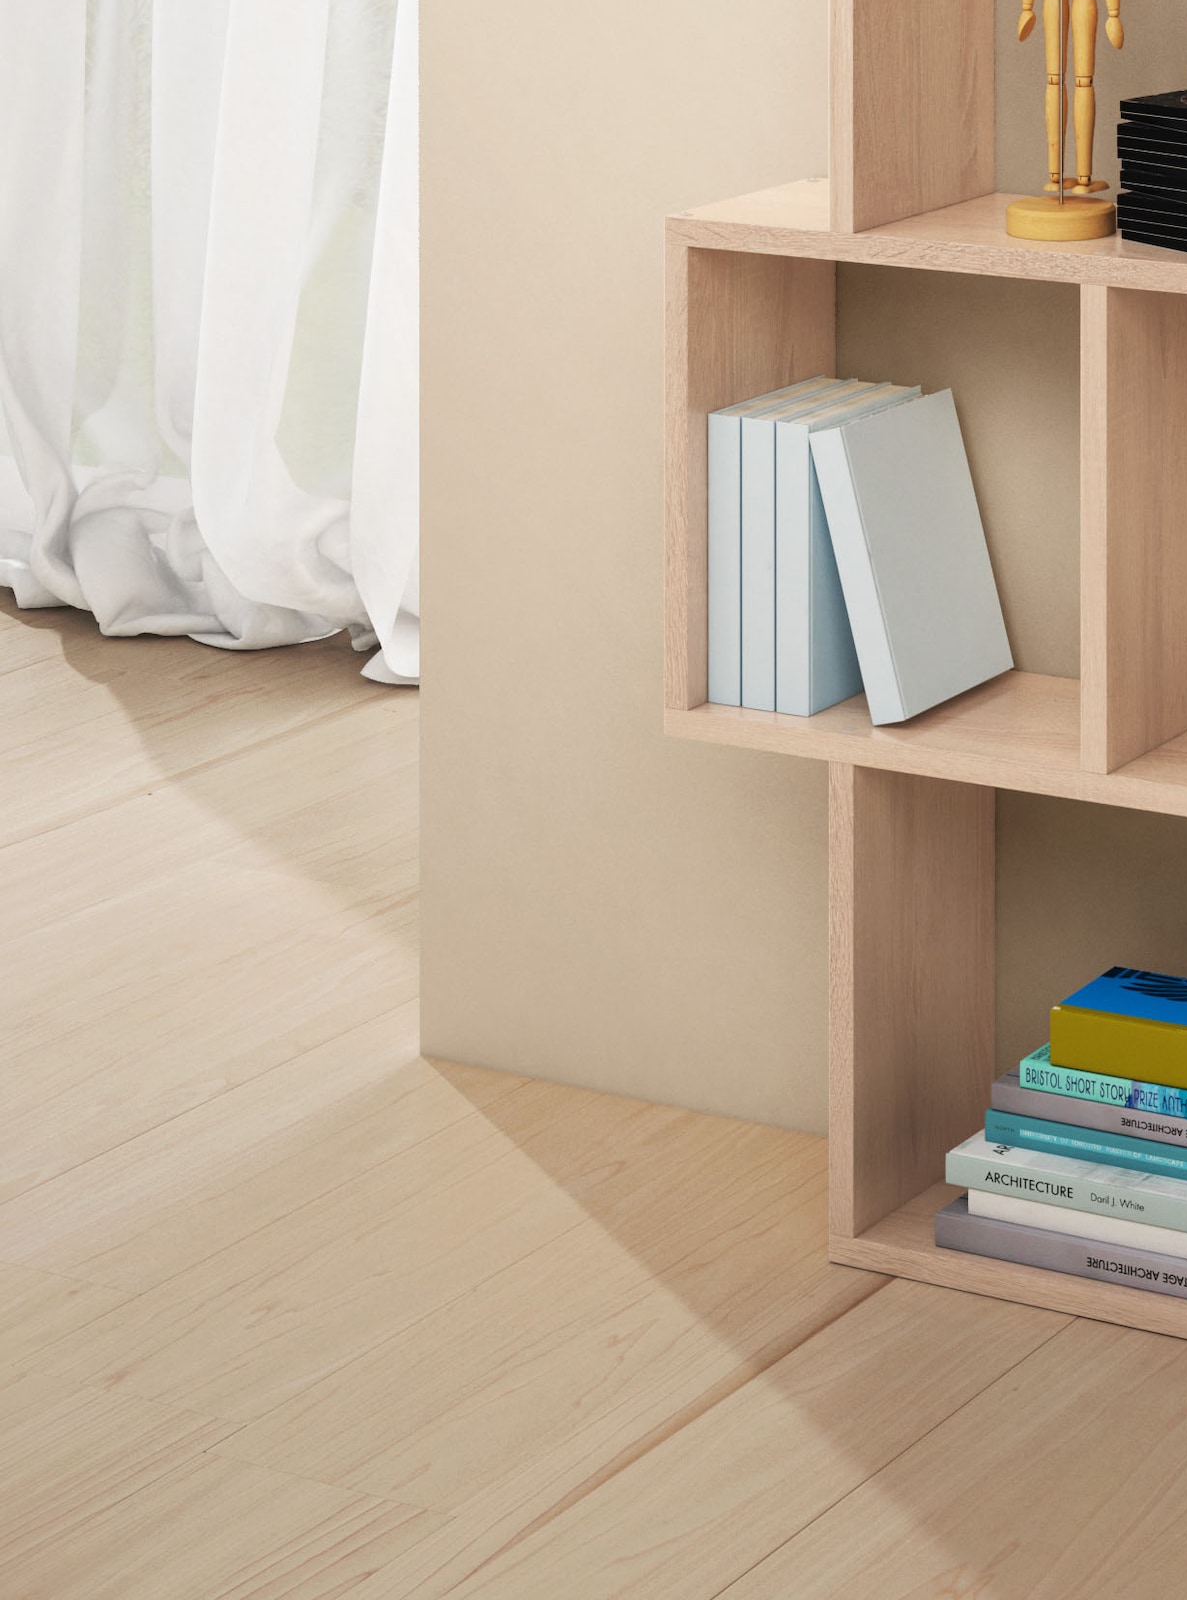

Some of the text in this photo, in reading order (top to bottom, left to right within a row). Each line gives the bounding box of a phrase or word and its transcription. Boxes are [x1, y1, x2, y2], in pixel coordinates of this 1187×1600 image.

[1025, 1067, 1062, 1089] BRISTOL
[1065, 1075, 1096, 1095] SHORT
[1099, 1082, 1130, 1103] STORY
[1133, 1088, 1158, 1109] PRIZE
[1121, 1117, 1183, 1137] ARCHITECTURE
[985, 1171, 1144, 1212] ARCHITECTURE Daril J. White
[1086, 1256, 1159, 1281] ARCHITECTURE
